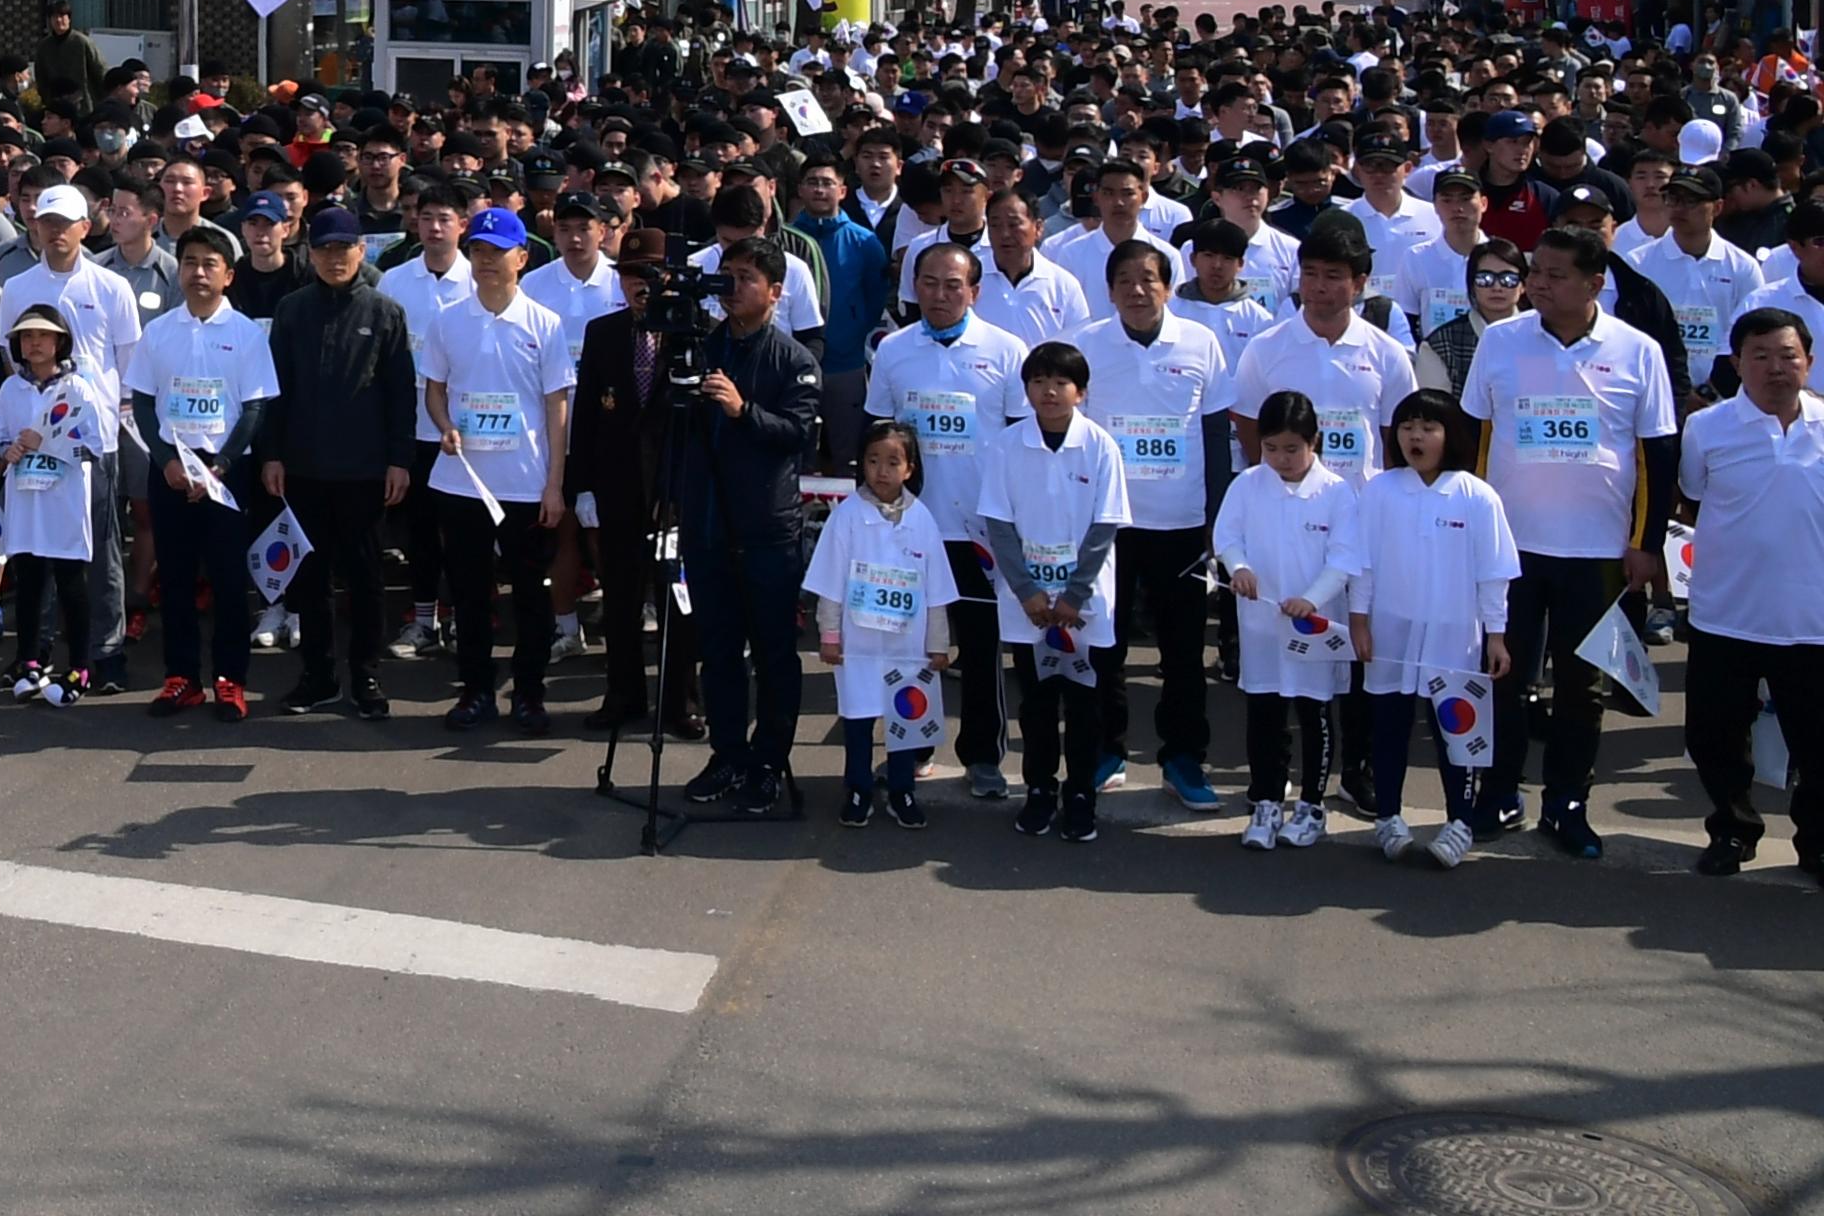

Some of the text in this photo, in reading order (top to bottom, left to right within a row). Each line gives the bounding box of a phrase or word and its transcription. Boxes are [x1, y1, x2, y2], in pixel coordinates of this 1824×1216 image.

[186, 397, 220, 414] 700
[475, 414, 512, 430] 777
[926, 414, 966, 433] 199
[1543, 419, 1589, 439] 366
[1136, 438, 1177, 457] 886
[25, 454, 58, 471] 726
[1028, 564, 1068, 582] 390
[875, 588, 913, 611] 389
